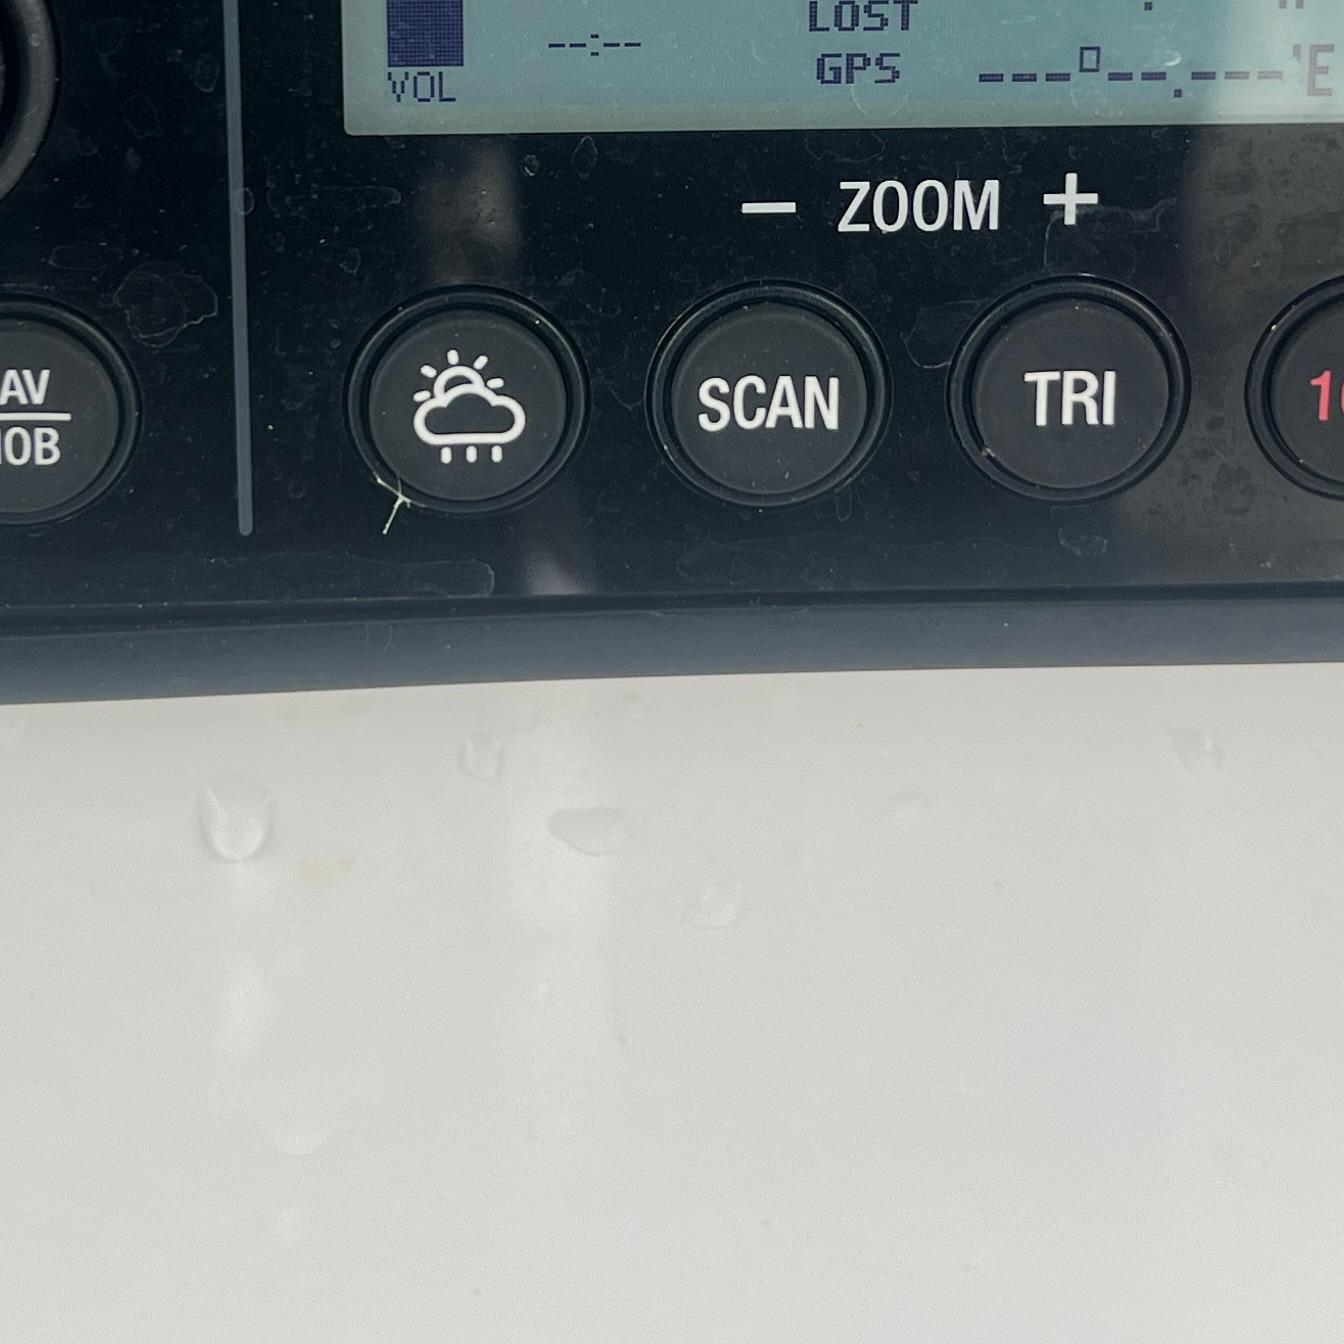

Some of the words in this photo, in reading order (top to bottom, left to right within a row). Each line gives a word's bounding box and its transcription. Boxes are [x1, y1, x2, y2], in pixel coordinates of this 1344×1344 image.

[808, 0, 919, 32] LOST
[387, 71, 457, 103] VOL
[815, 52, 902, 85] GPS
[837, 179, 1000, 234] ZOOM
[698, 375, 840, 432] SCAN
[1024, 370, 1117, 427] TRI
